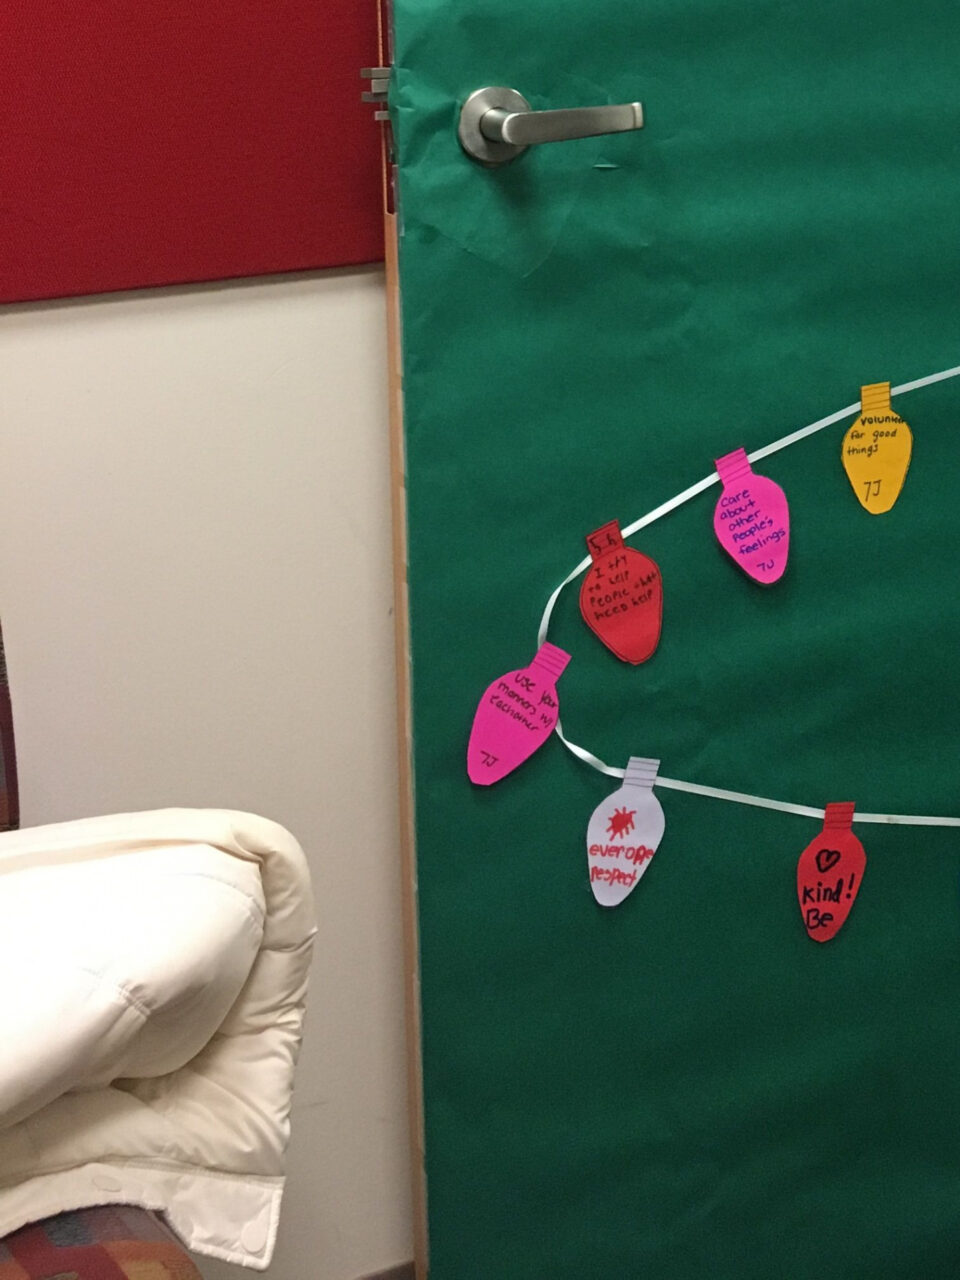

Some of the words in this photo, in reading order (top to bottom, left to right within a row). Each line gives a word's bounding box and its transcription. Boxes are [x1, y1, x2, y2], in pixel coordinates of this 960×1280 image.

[873, 429, 898, 442] good
[847, 445, 879, 457] things
[864, 480, 882, 502] 7J
[720, 500, 756, 519] about
[728, 510, 761, 532] other
[738, 528, 786, 555] feelings
[595, 568, 605, 579] I
[480, 750, 499, 767] 7J
[805, 908, 834, 930] Be
